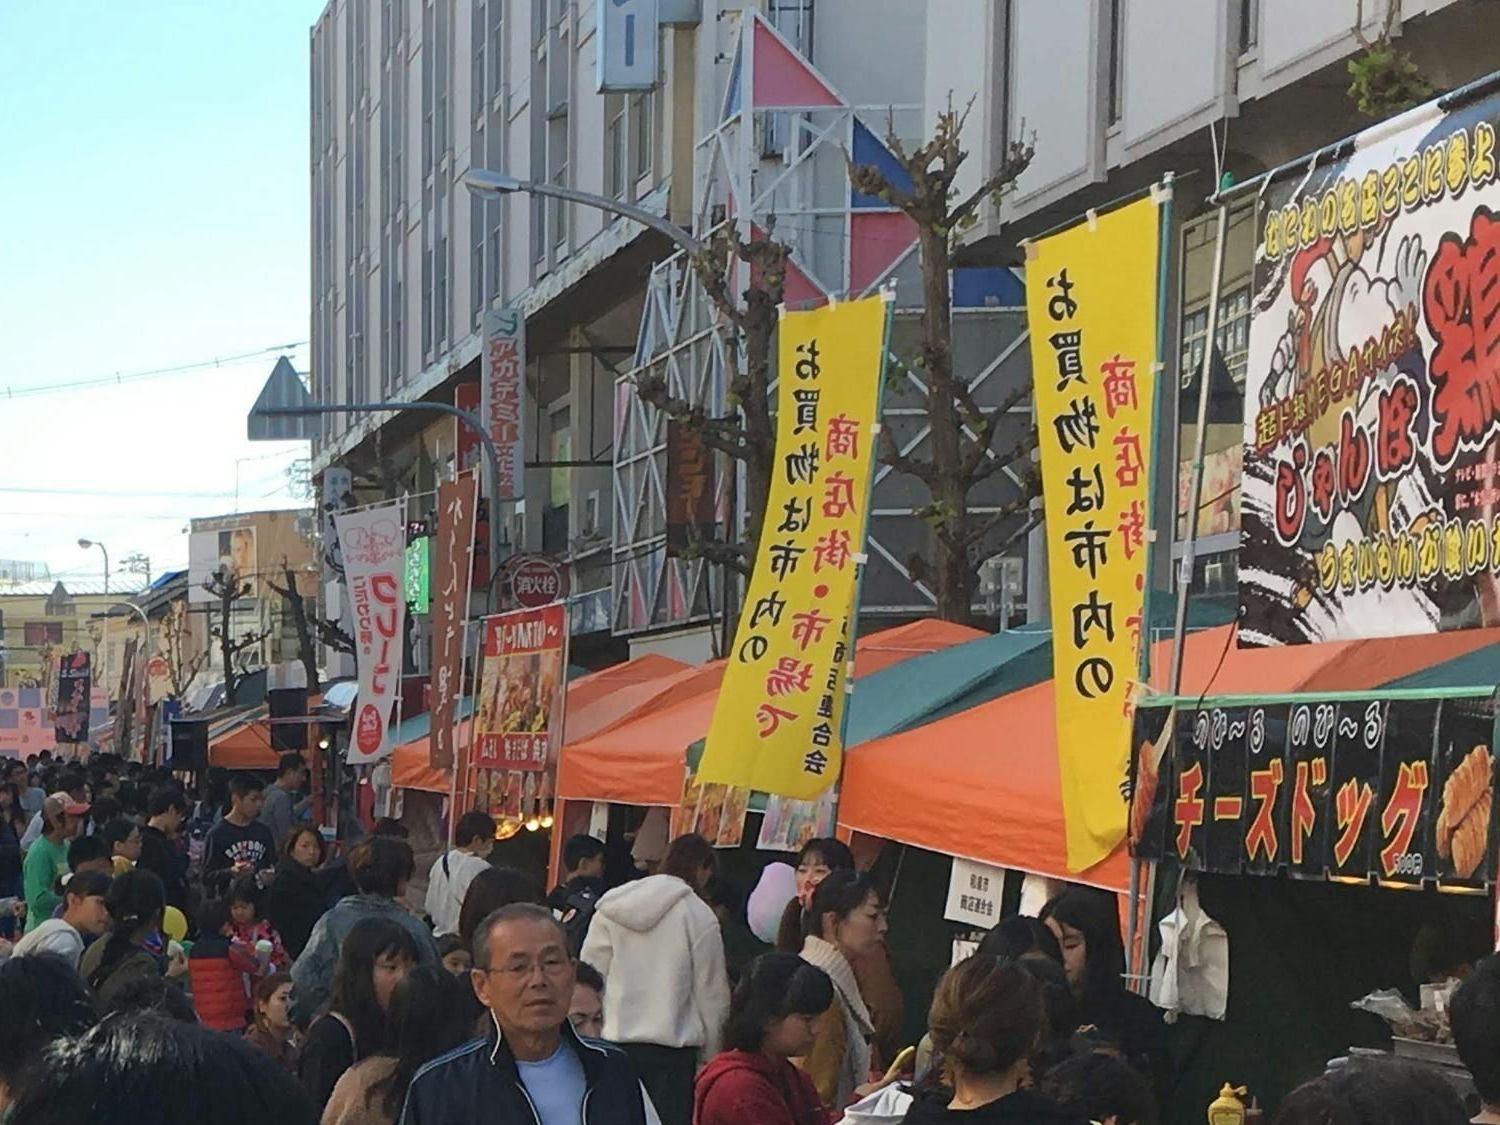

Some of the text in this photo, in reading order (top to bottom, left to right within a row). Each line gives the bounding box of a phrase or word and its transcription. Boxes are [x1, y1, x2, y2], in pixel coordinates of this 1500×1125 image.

[517, 575, 556, 594] 消火栓
[1174, 757, 1428, 878] チーズドッグ
